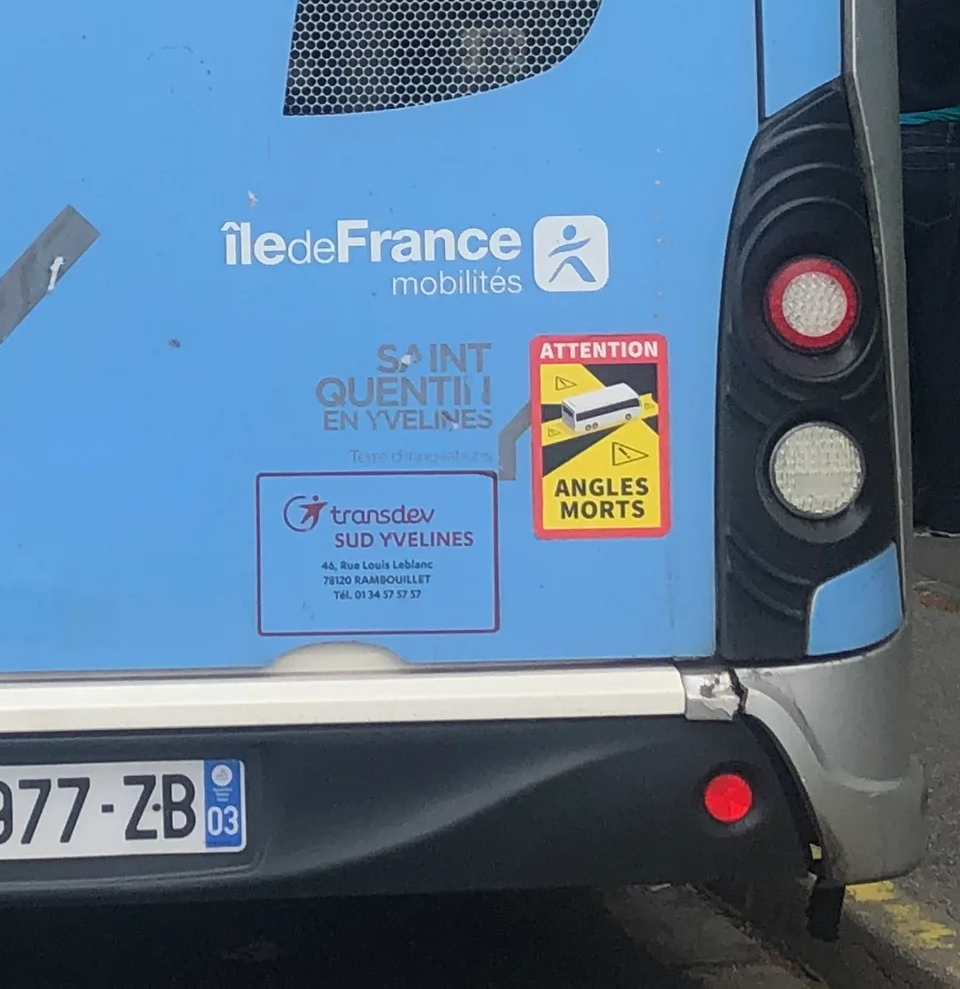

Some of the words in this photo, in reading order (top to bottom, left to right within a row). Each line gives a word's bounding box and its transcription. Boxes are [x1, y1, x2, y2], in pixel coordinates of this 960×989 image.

[392, 267, 522, 296] mobilités
[377, 342, 492, 374] SAINT
[539, 340, 659, 360] ATTENTION
[323, 409, 359, 431] EN
[366, 408, 493, 432] YVELINES
[554, 476, 649, 497] ANGLES
[330, 504, 435, 525] transdev
[560, 499, 645, 520] MORTS
[334, 532, 374, 549] SUD
[379, 530, 474, 548] YVELINES
[340, 560, 360, 570] Rue
[362, 559, 390, 570] Louis
[392, 558, 433, 570] Leblanc
[323, 575, 352, 586] 78120
[354, 574, 432, 586] RAMBOUILLET
[207, 804, 239, 836] 03
